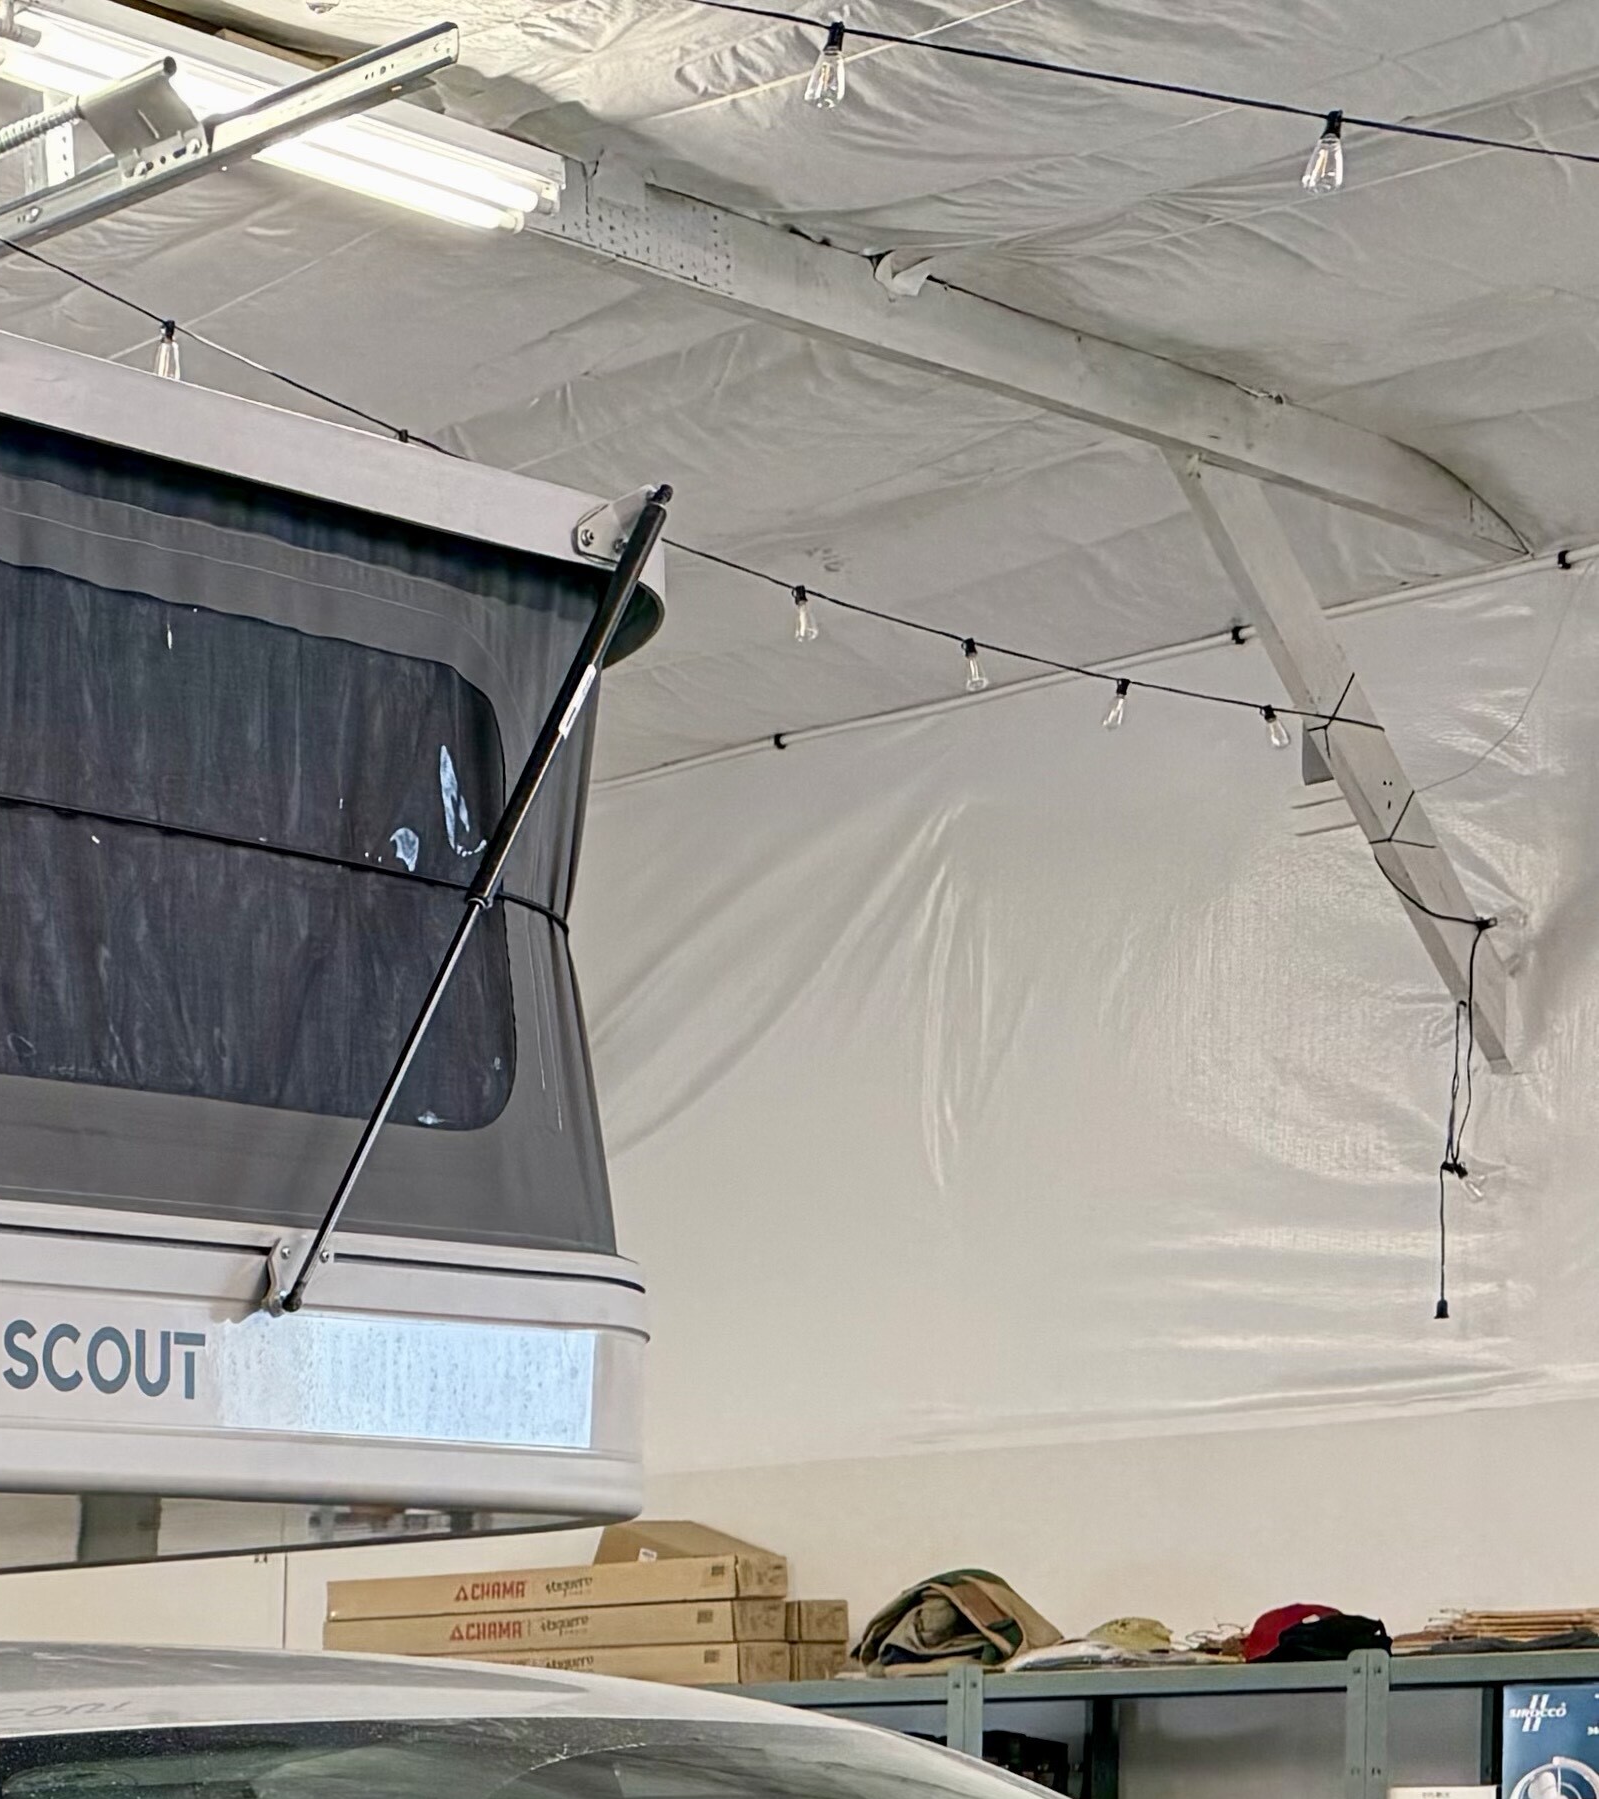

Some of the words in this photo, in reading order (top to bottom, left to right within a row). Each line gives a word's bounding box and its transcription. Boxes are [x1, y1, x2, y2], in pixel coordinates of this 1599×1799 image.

[3, 1319, 206, 1400] SCOUT
[470, 1580, 526, 1599] CHAMA
[465, 1620, 523, 1641] CHAMA
